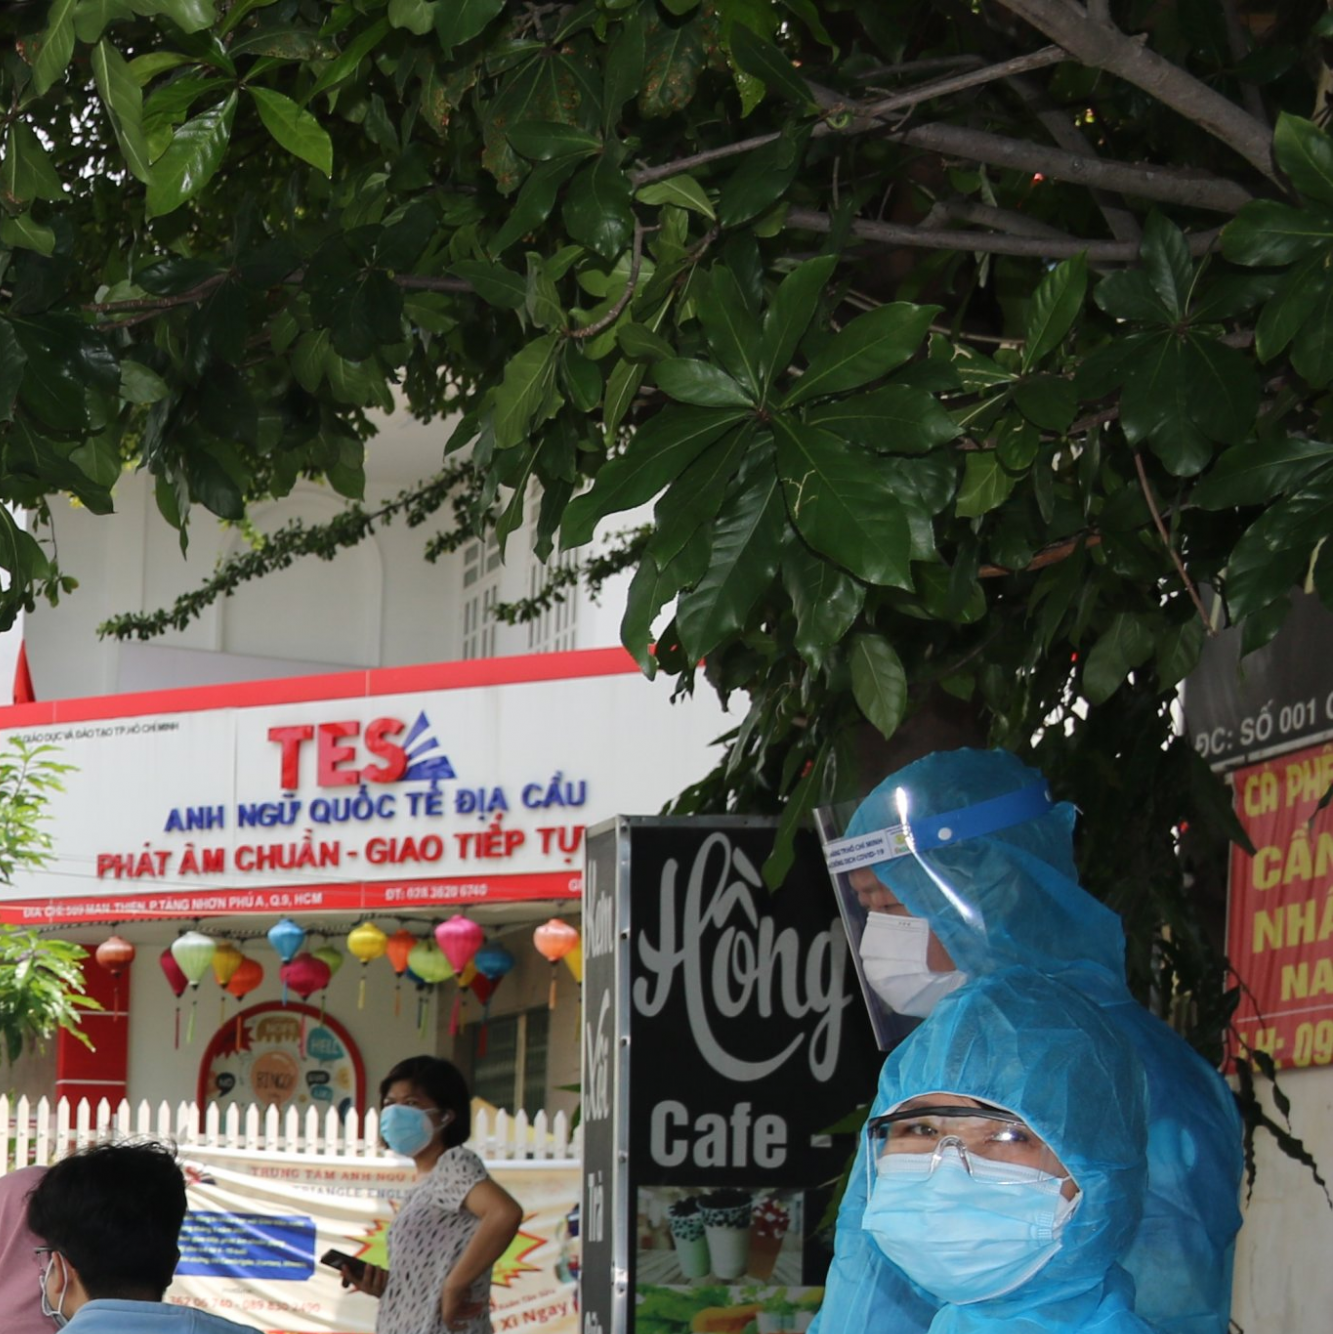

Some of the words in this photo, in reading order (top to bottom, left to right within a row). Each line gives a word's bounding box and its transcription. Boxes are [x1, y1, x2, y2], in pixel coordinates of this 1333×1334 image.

[1240, 698, 1273, 746] SỐ
[1279, 697, 1316, 734] 001
[268, 717, 408, 790] TES
[164, 805, 225, 832] ANH
[238, 793, 301, 828] NGỮ
[309, 784, 396, 823] QUỐC
[405, 779, 443, 816] TẾ
[454, 786, 509, 821] ĐỊA
[521, 770, 587, 809] CẦU
[1243, 763, 1279, 817] CÀ
[96, 842, 173, 880] PHÁT
[178, 842, 225, 876] ÂM
[234, 828, 340, 872] CHUẨN
[365, 833, 444, 866] GIAO
[453, 812, 525, 861] TIẾP
[536, 824, 586, 865] TỰ
[191, 897, 227, 910] NHƠN
[229, 890, 255, 908] PHÚ
[294, 892, 323, 905] HCM
[633, 831, 853, 1082] Hồng
[650, 1100, 787, 1170] Cafe
[251, 1166, 299, 1179] TRUNG
[341, 1171, 371, 1182] ANH
[521, 1301, 567, 1324] Ngay
